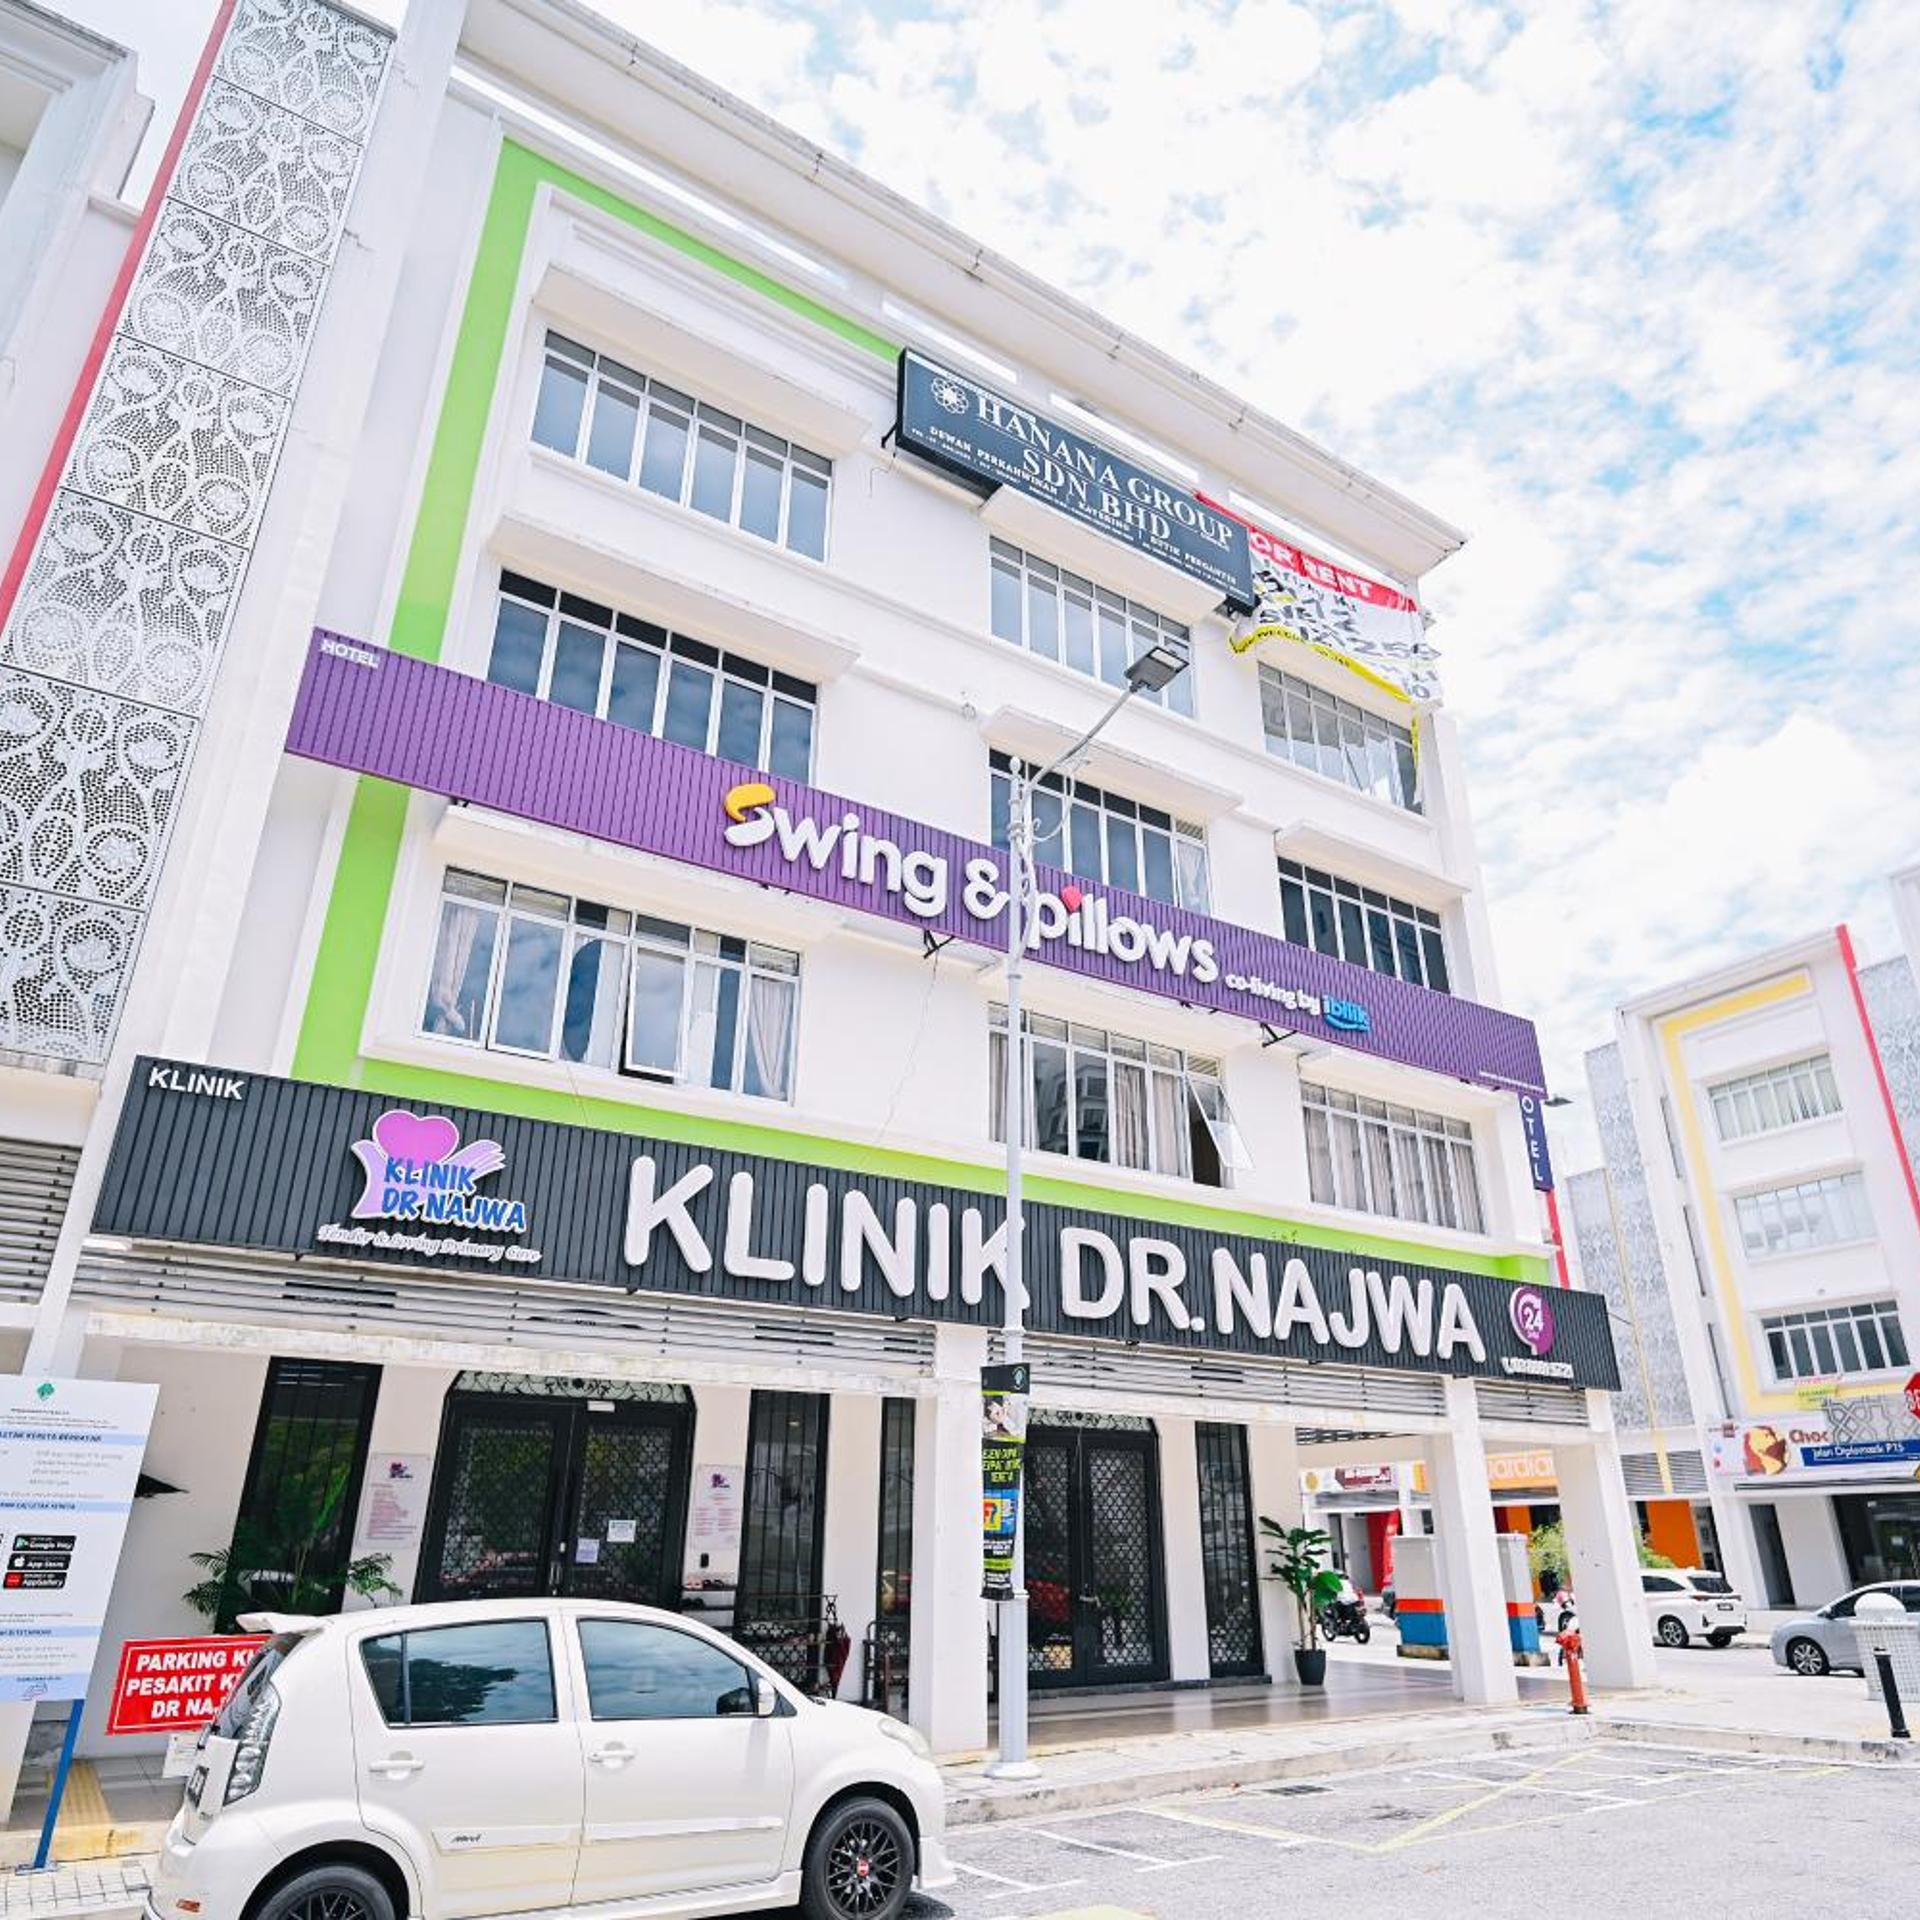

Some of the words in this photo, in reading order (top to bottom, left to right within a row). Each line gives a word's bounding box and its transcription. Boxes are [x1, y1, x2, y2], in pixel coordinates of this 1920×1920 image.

[977, 396, 1120, 491] HANANA
[1127, 477, 1233, 545] GROUP
[1023, 448, 1088, 503] SDN
[1101, 491, 1171, 540] BHD
[1249, 533, 1294, 567] OR
[1301, 555, 1370, 598] RENT
[321, 639, 379, 669] HOTEL
[724, 783, 947, 918] Swing
[962, 858, 1010, 921] &
[1026, 886, 1218, 983] pillows
[1297, 989, 1320, 1015] by
[149, 1067, 245, 1100] KLINIK
[384, 1157, 476, 1192] KLINIK
[382, 1187, 419, 1217] DR
[424, 1191, 525, 1230] NAJWA
[624, 1155, 1031, 1311] KLINIK
[1523, 1306, 1544, 1332] 24
[136, 1651, 226, 1673] PARKING
[126, 1674, 216, 1697] PESAKIT
[151, 1700, 180, 1719] DR
